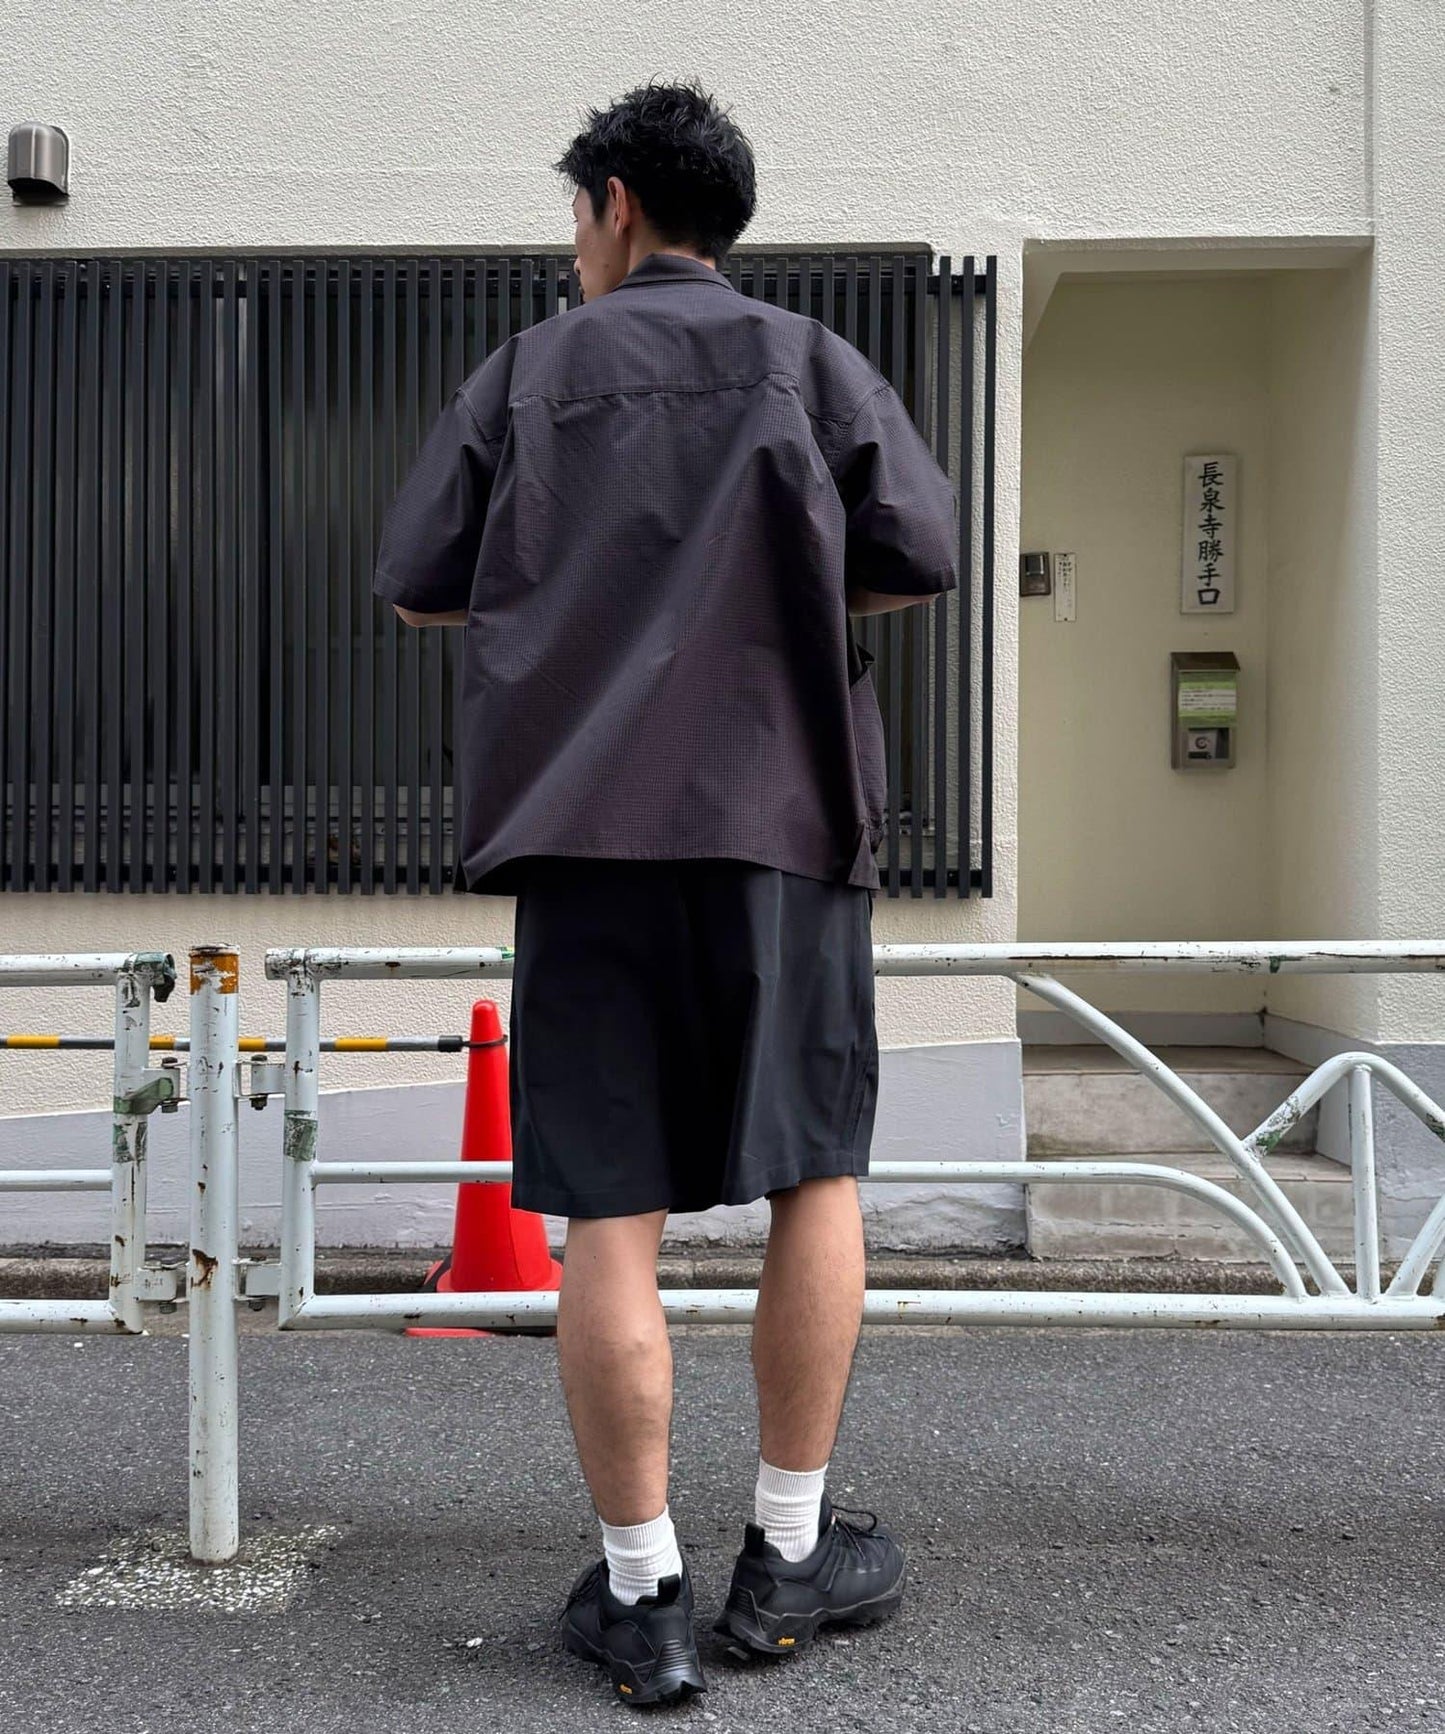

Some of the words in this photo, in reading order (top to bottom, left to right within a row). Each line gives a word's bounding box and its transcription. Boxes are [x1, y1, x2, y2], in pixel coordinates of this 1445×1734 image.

[1197, 462, 1225, 605] 長泉寺勝手口
